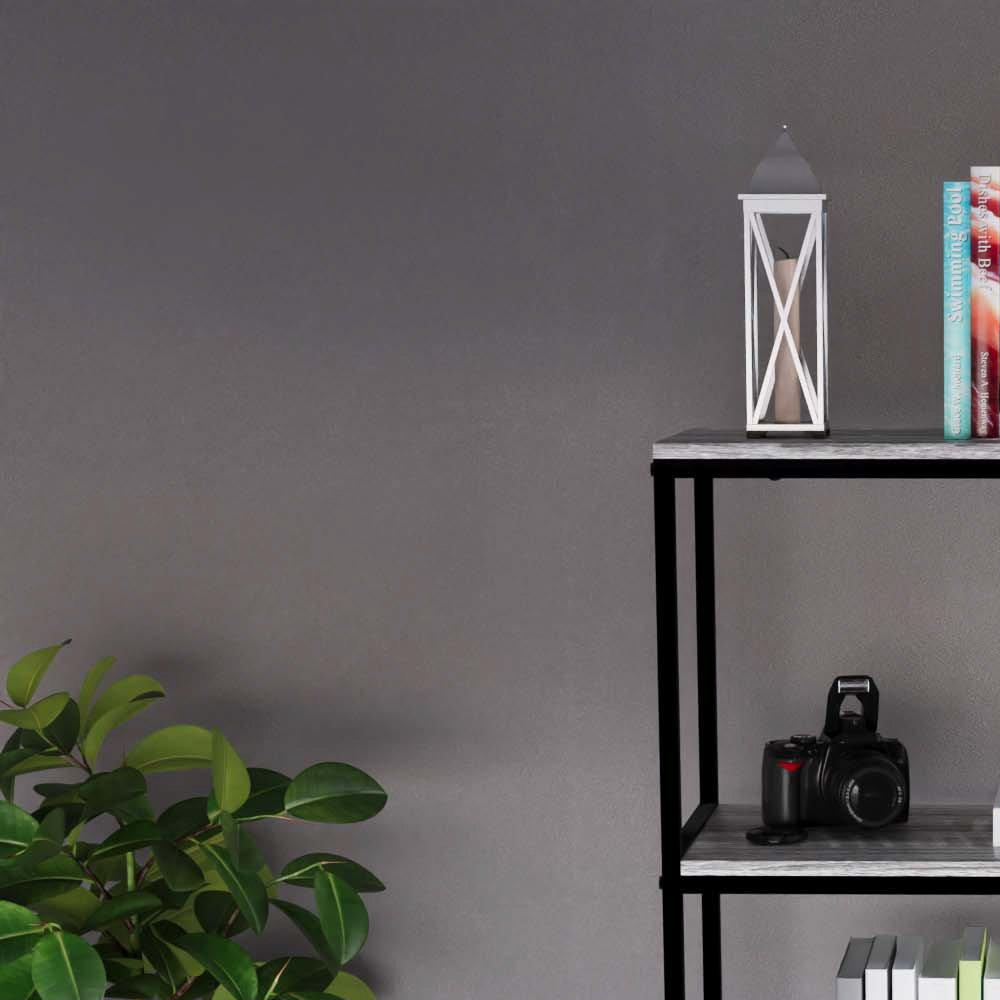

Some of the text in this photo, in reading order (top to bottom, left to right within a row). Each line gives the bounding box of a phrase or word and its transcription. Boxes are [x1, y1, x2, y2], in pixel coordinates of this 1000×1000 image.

[947, 186, 967, 323] Swimming Pool
[978, 174, 992, 295] Dishes with Beef
[980, 351, 990, 378] Steven
